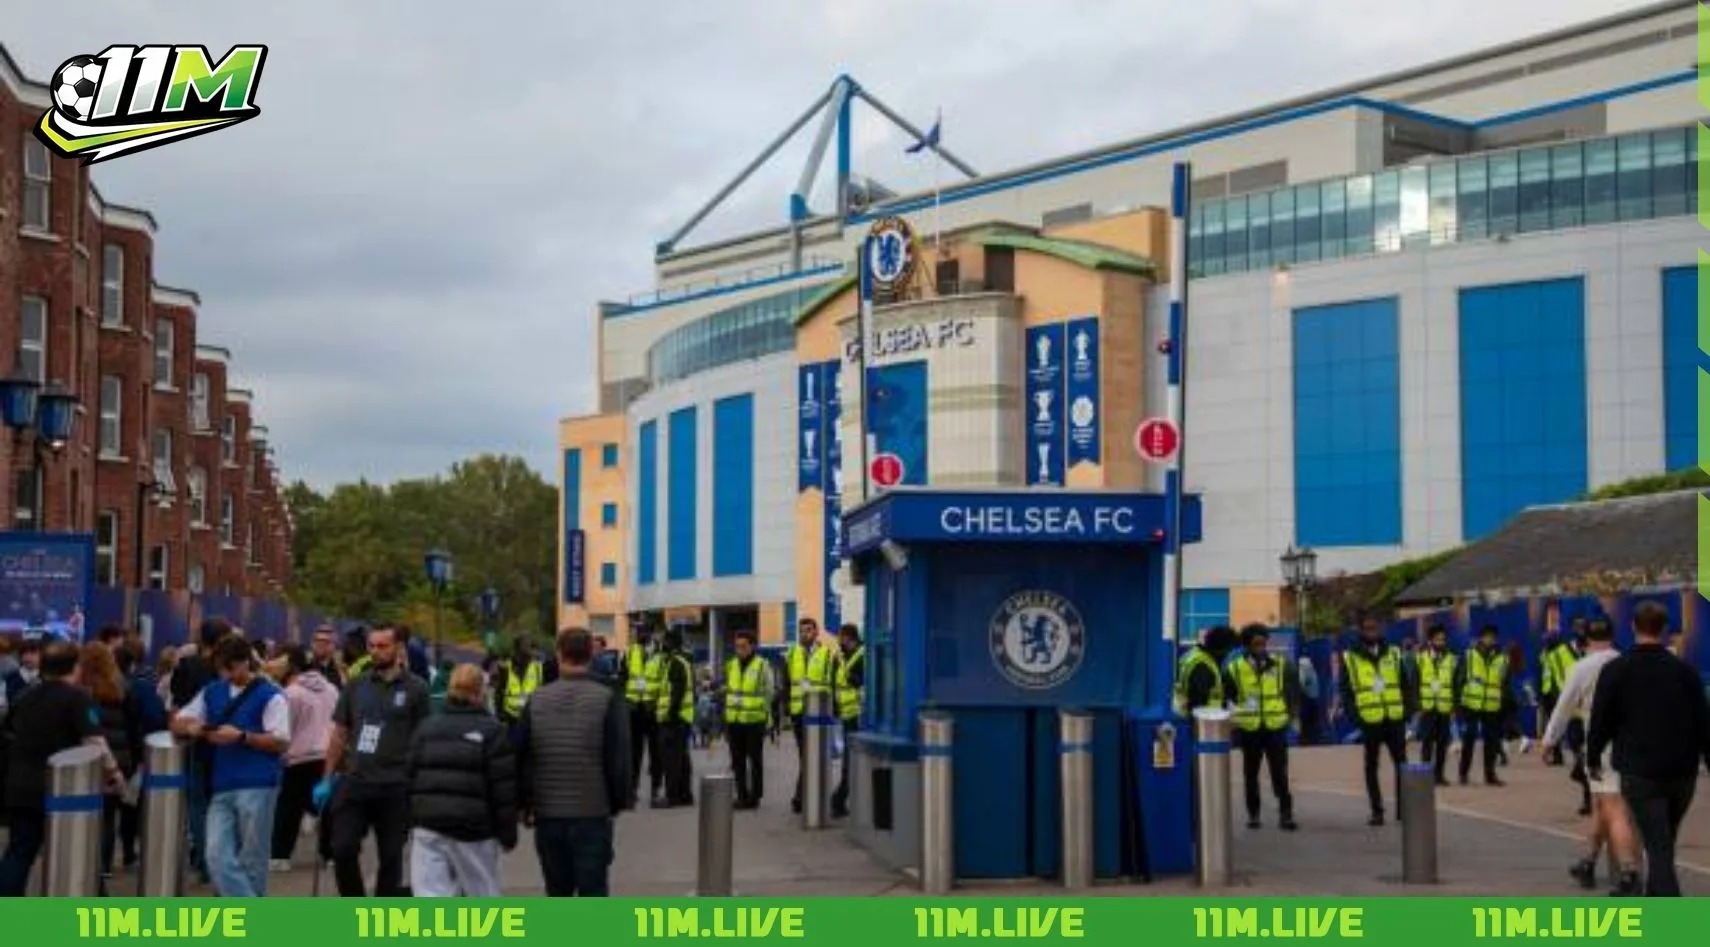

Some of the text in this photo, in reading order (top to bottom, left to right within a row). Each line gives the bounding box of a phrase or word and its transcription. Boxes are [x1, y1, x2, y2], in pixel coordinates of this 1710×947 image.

[938, 317, 976, 349] FC
[940, 506, 1136, 534] CHELSEA FC
[1003, 592, 1068, 615] CHELSEA
